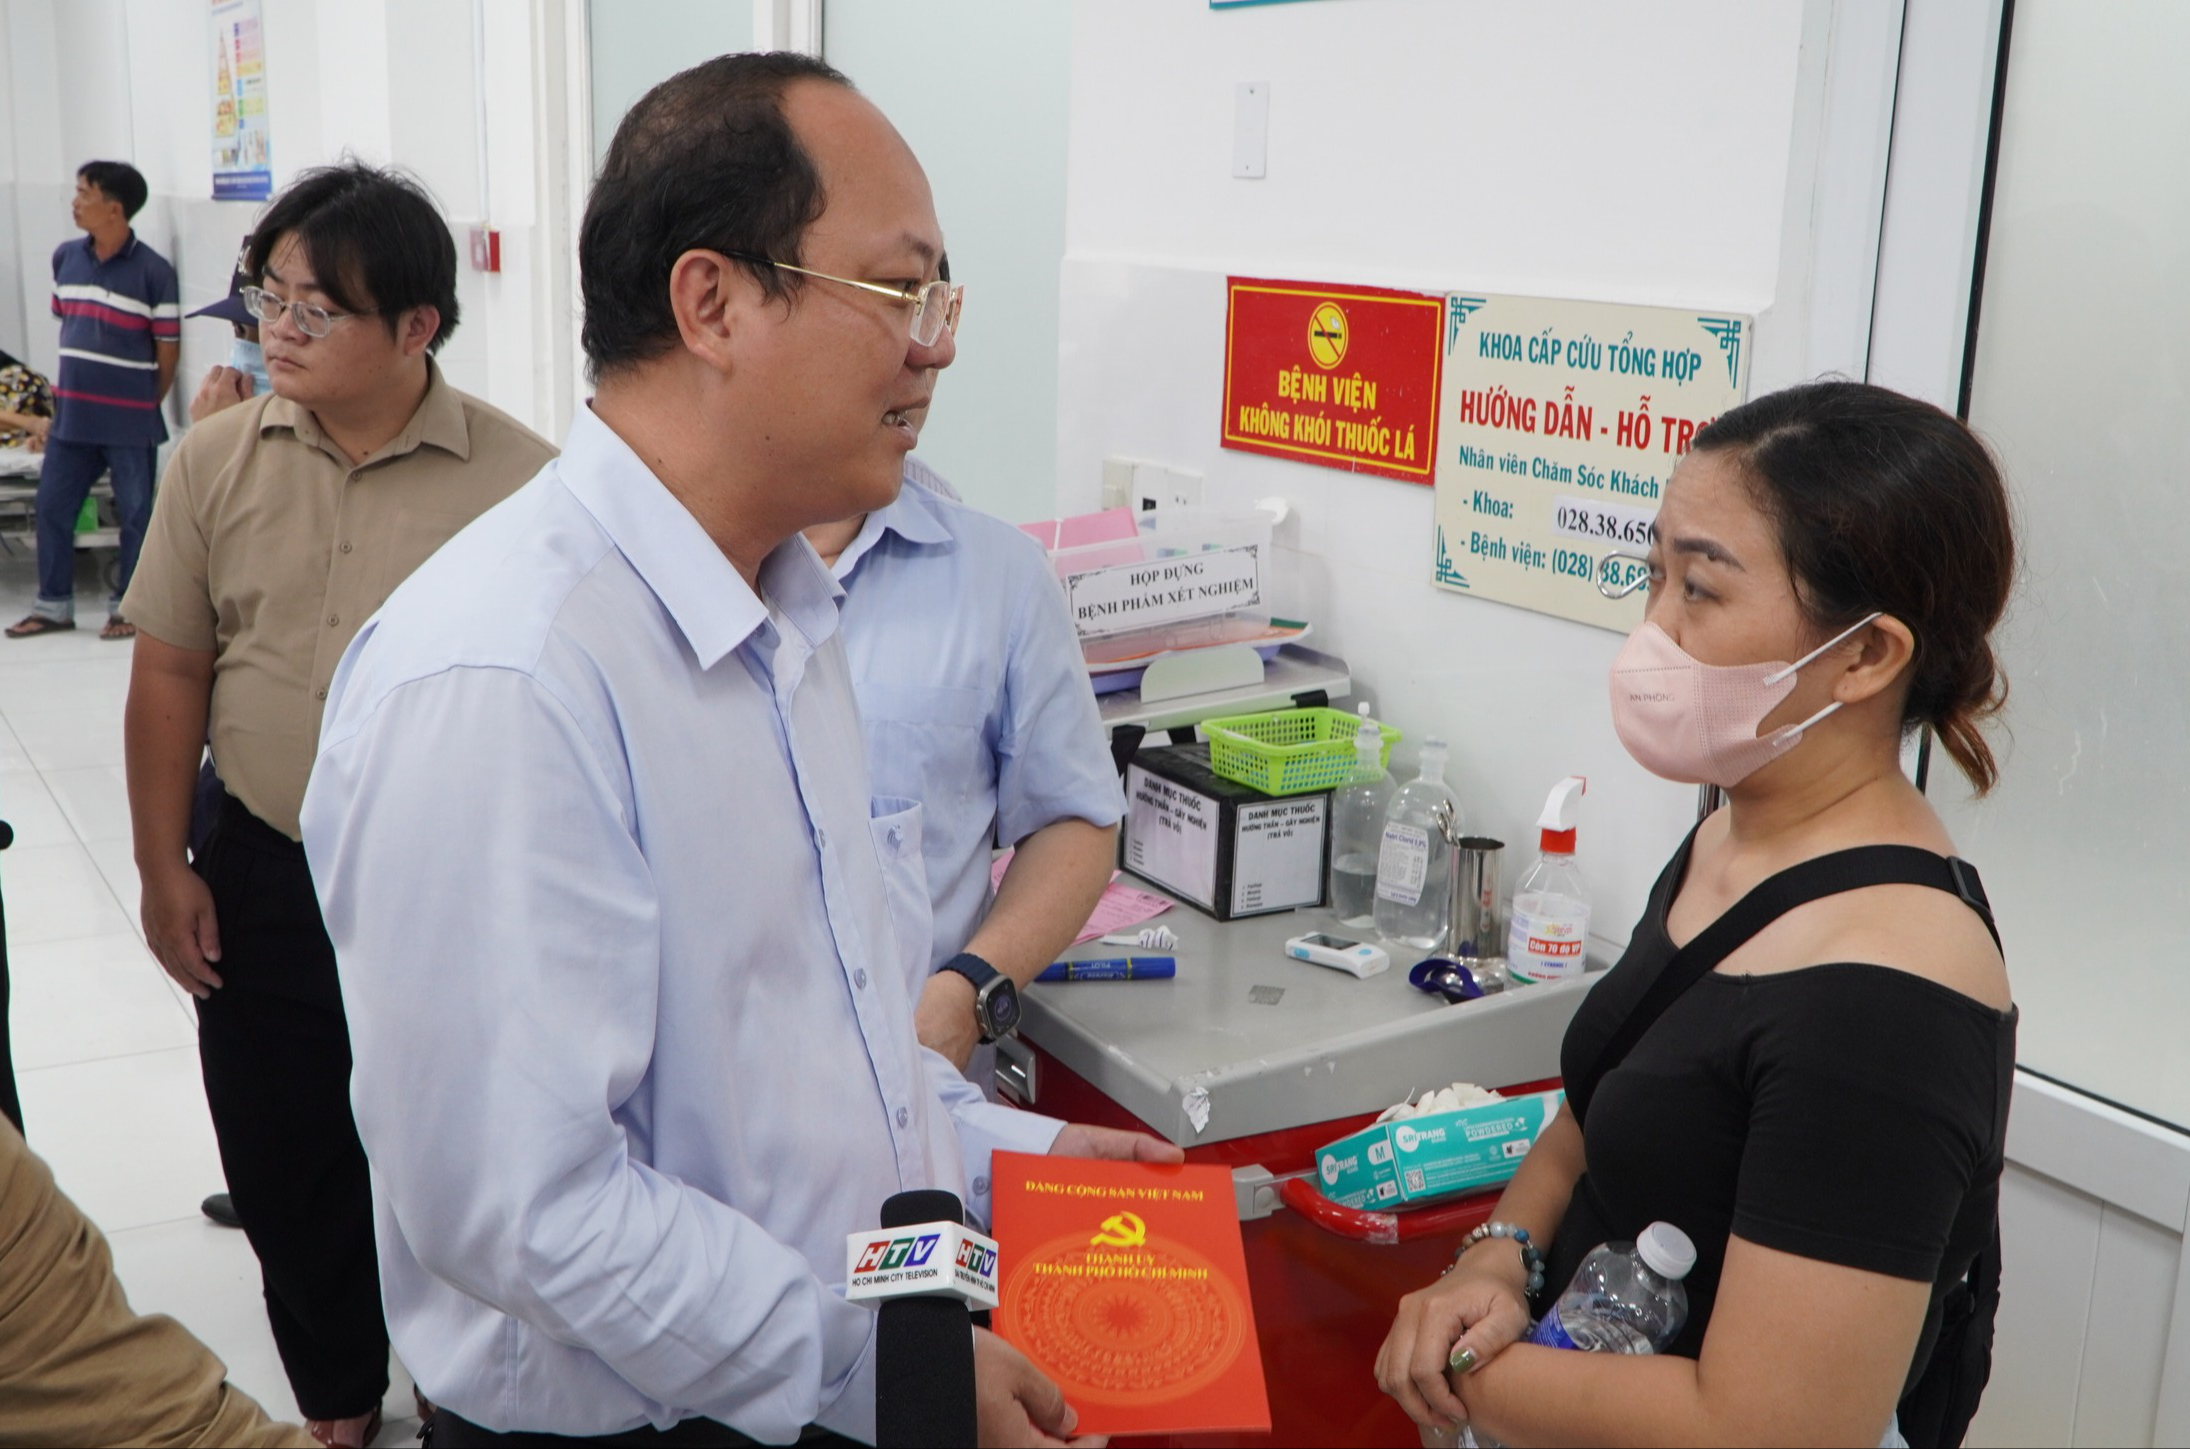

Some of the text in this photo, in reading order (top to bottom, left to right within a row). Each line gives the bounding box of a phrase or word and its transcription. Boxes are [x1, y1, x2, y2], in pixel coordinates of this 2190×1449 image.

[1479, 327, 1702, 386] KHOA CẤP CỨU TỔNG HỢP
[1278, 364, 1377, 413] BỆNH VIỆN
[1239, 401, 1415, 461] KHÔNG KHÓI THUỐC LÁ
[1460, 384, 1536, 434] HƯỚNG
[1544, 385, 1593, 442] DẪN
[1616, 394, 1651, 450] HỖ
[1459, 445, 1659, 498] Nhân viên Chăm Sóc Khách
[1472, 490, 1514, 519] Khoa:
[1470, 531, 1507, 562] Bệnh
[1512, 541, 1546, 571] viện:
[1552, 548, 1594, 582] (028)
[1130, 570, 1160, 587] HỘP
[1078, 602, 1117, 621] BỆNH
[1199, 577, 1254, 598] NGHIỆM
[1144, 777, 1162, 794] DANH
[1248, 810, 1269, 820] DANH
[1548, 943, 1558, 954] 70
[1375, 1145, 1386, 1160] M
[854, 1234, 941, 1273] HTV
[955, 1238, 997, 1278] HTV
[862, 1275, 872, 1285] CHI
[874, 1274, 889, 1284] MINH
[891, 1272, 903, 1282] CITY
[905, 1269, 938, 1281] TELEVISION
